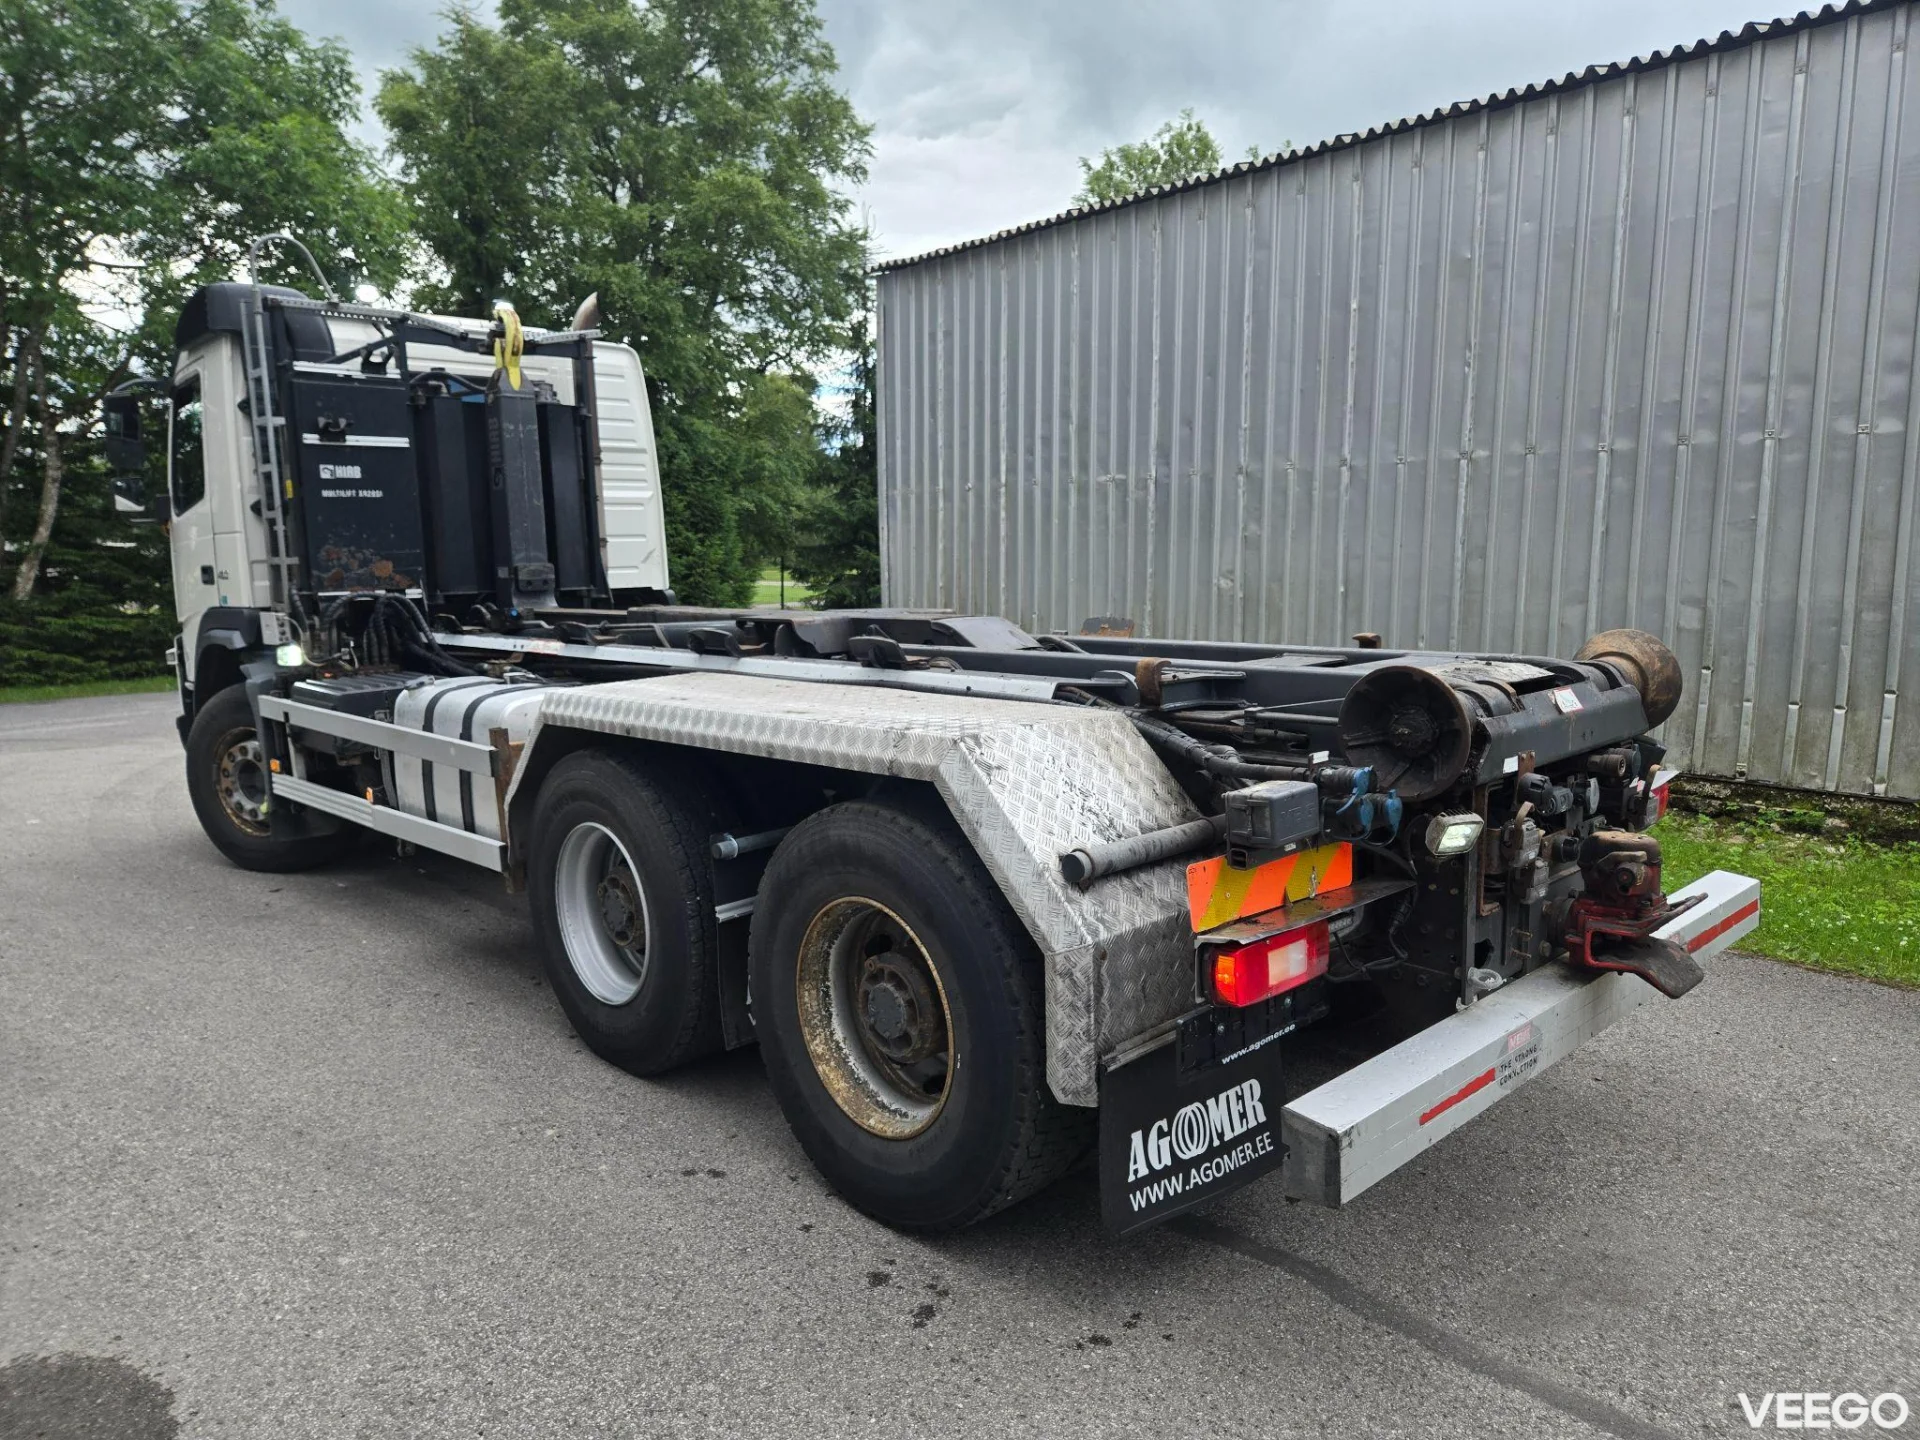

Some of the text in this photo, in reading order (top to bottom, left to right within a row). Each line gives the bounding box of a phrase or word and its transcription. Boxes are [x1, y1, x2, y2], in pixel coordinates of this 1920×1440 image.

[335, 465, 362, 479] HIAB
[1221, 1023, 1296, 1065] www.agomer.ee
[1128, 1078, 1267, 1183] AGOMER
[1129, 1131, 1274, 1212] WWW.AGOMER.EE
